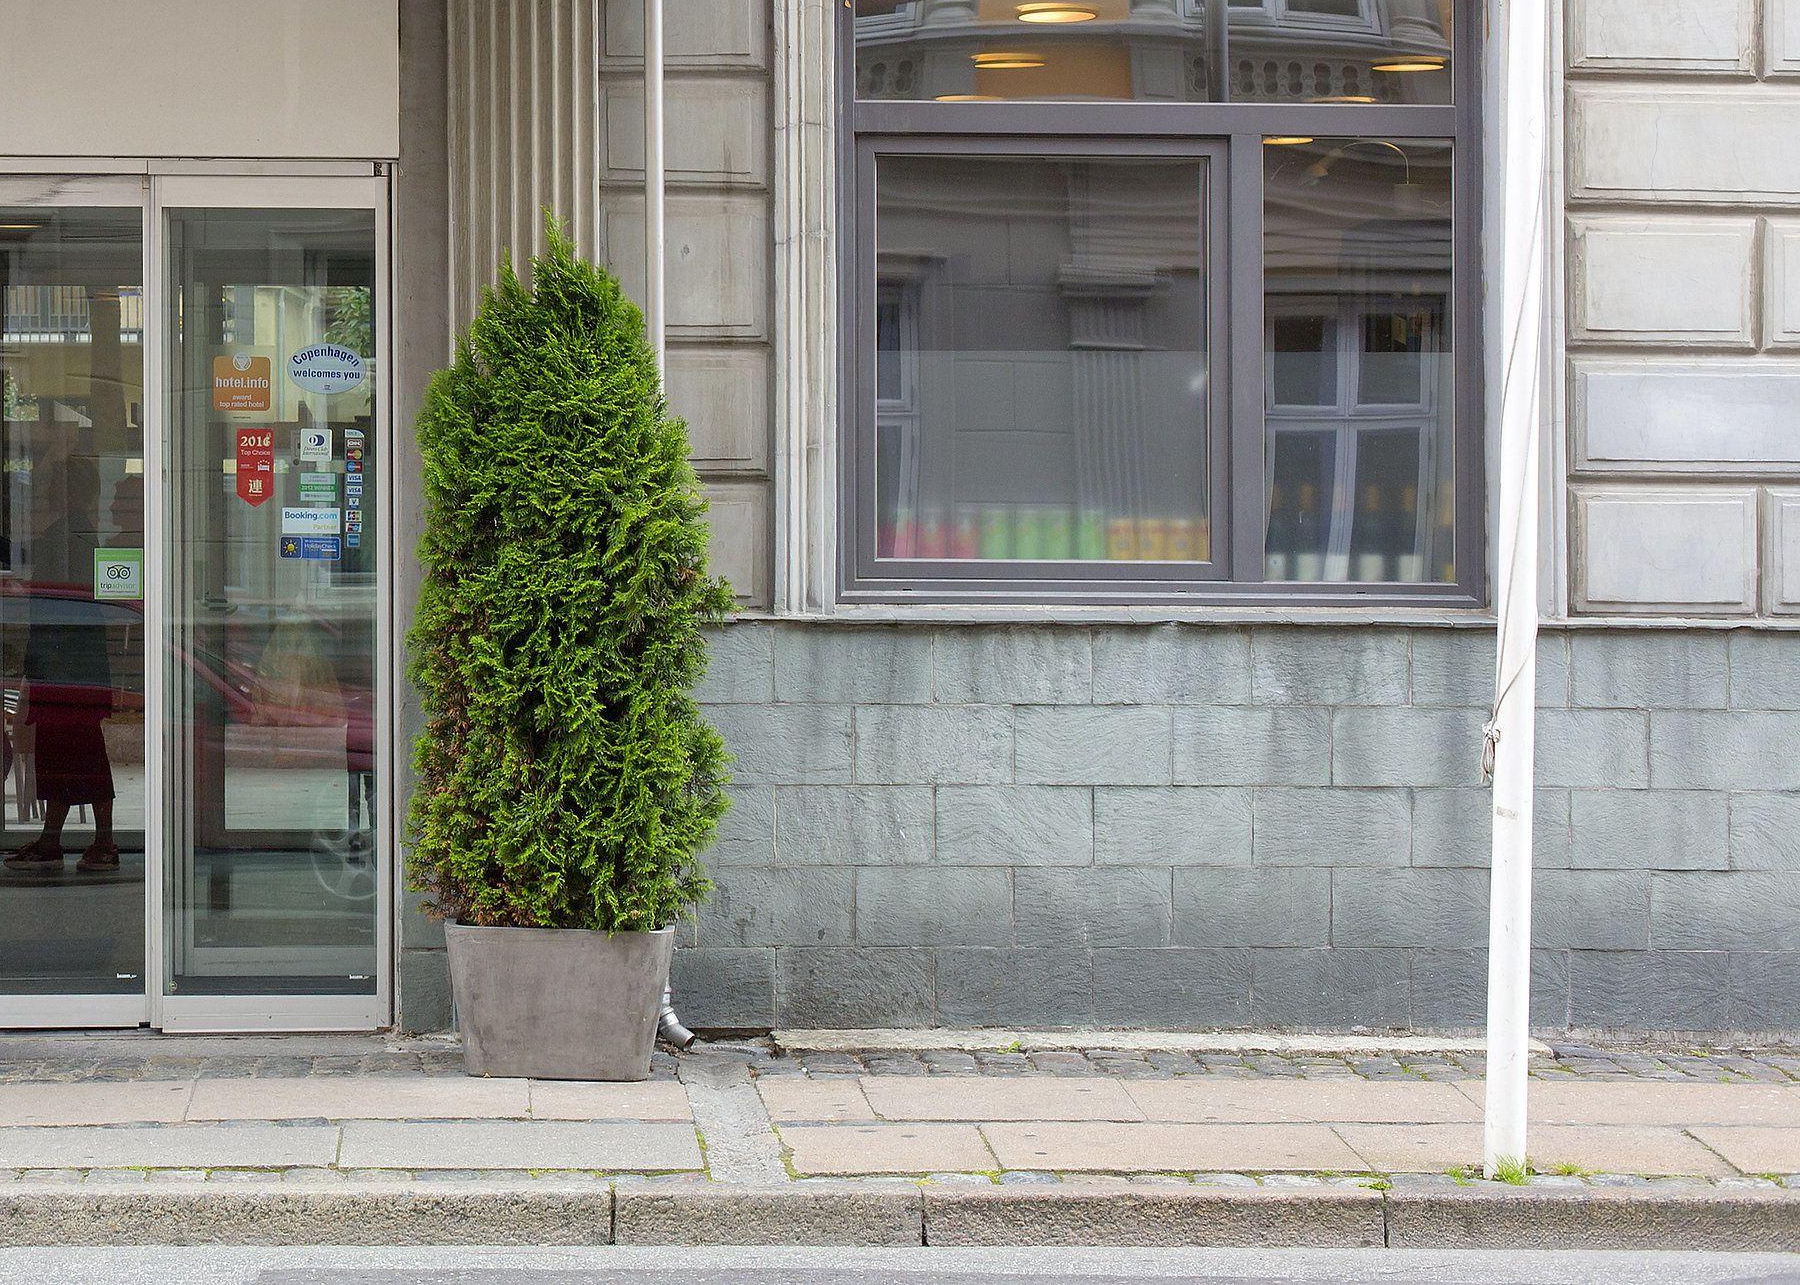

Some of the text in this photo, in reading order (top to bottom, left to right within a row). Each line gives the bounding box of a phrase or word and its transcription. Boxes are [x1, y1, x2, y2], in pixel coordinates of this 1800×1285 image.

[292, 346, 360, 367] Copenhagen
[293, 368, 360, 381] welcomes you
[215, 376, 269, 389] hotel.info
[240, 435, 271, 447] 2016
[240, 449, 252, 457] Top
[284, 511, 338, 521] Booking.com
